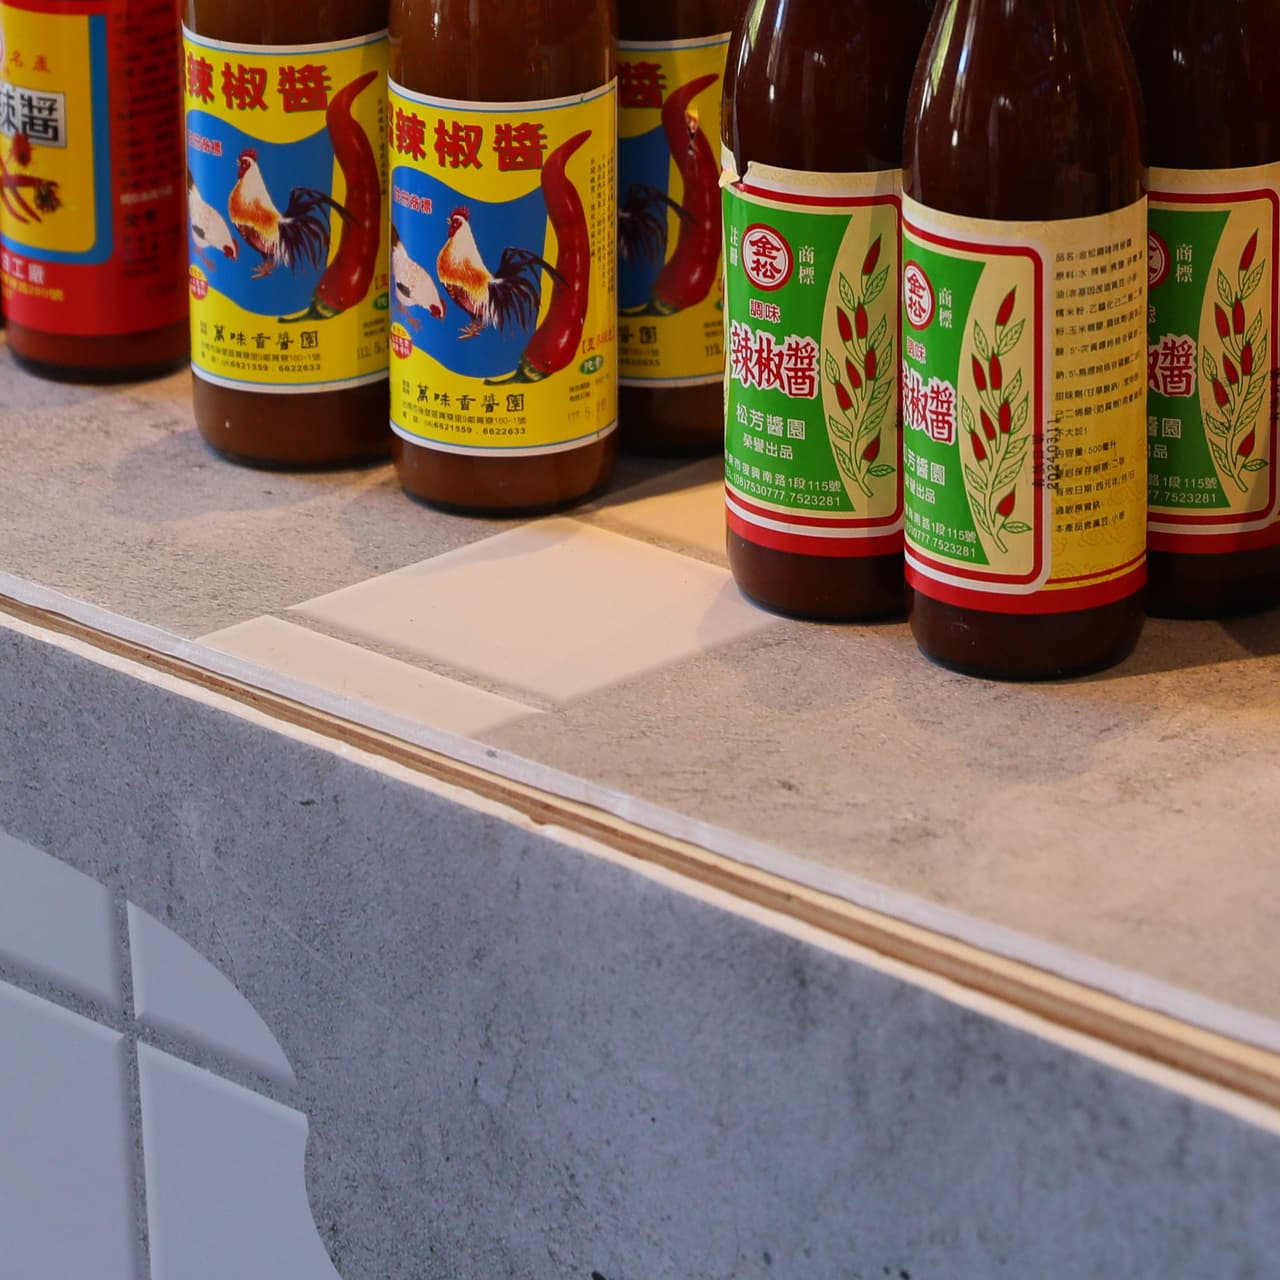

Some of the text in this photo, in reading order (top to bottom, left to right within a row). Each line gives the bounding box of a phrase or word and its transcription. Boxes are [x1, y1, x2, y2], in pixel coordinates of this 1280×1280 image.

[186, 52, 333, 114] 辣椒醬
[749, 234, 782, 281] 金松
[798, 245, 816, 285] 商標
[1175, 242, 1193, 283] 商標
[749, 299, 781, 323] 調味
[906, 272, 927, 319] 金松
[938, 287, 953, 329] 商標
[730, 321, 820, 400] 辣椒醬
[736, 402, 806, 441] 松芳醬園
[904, 445, 946, 487] 芳醬園
